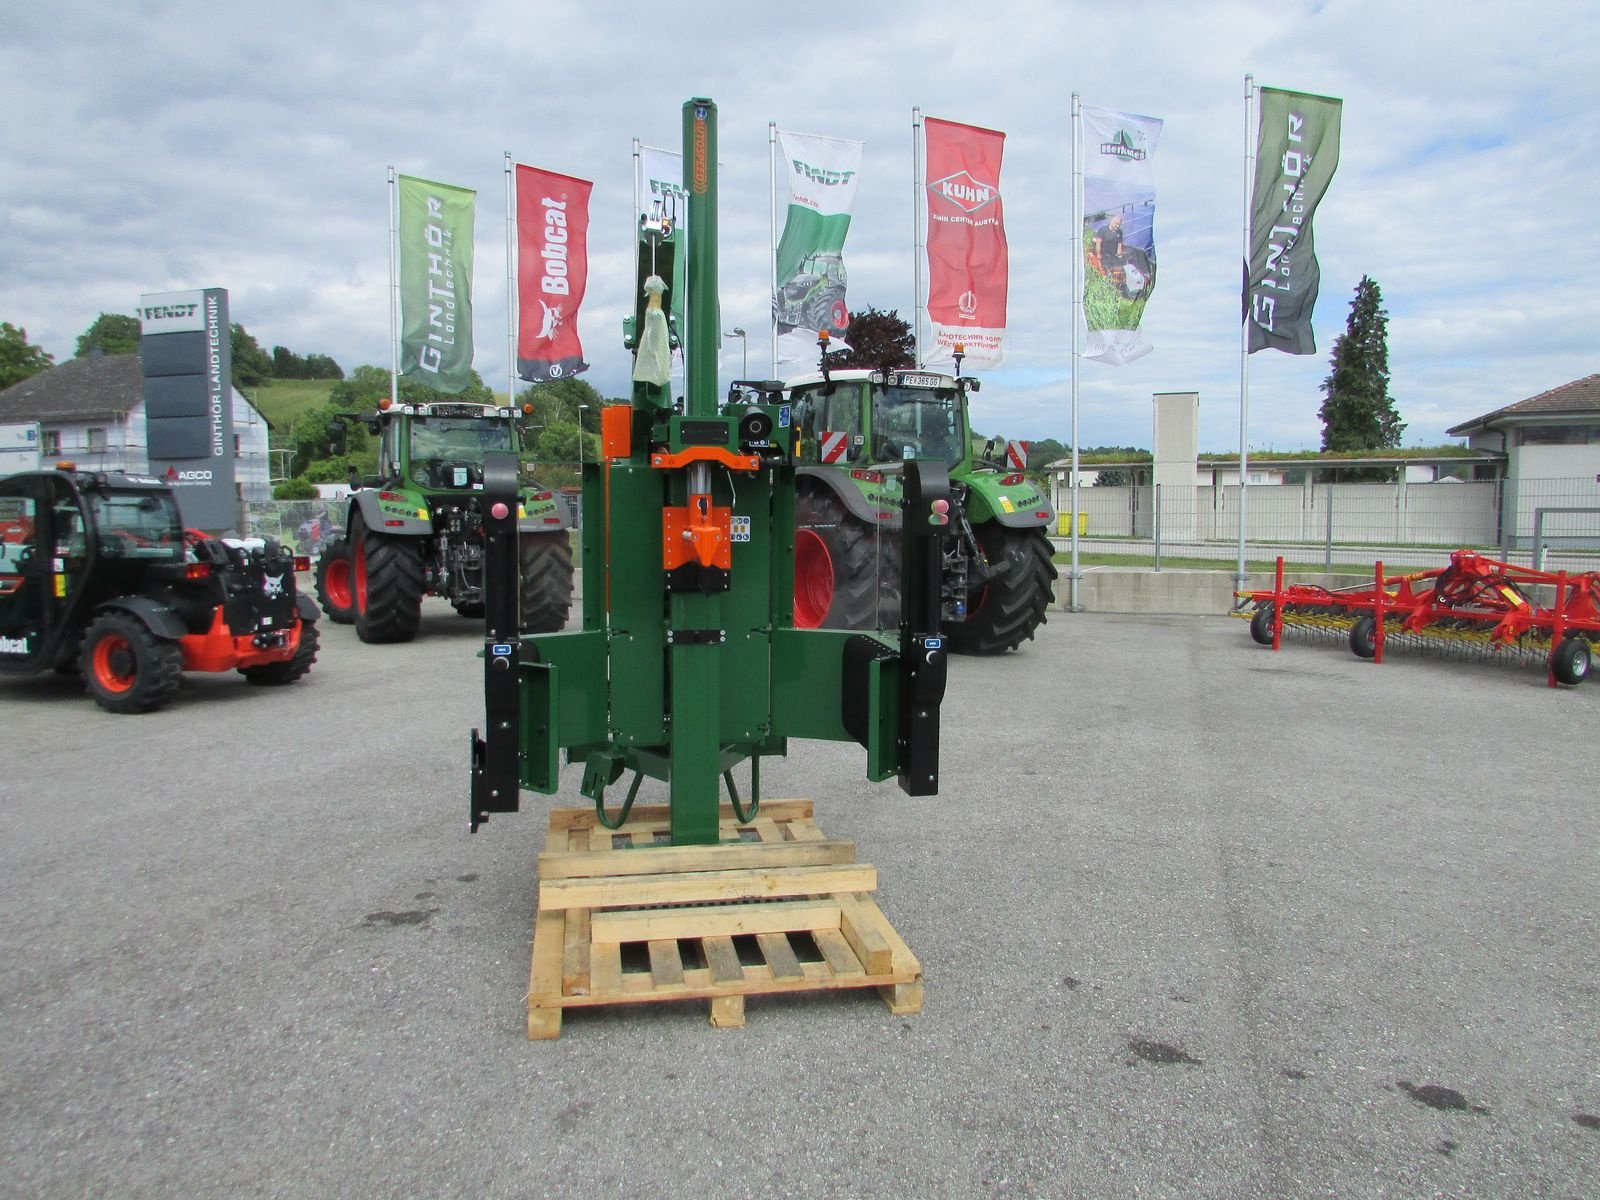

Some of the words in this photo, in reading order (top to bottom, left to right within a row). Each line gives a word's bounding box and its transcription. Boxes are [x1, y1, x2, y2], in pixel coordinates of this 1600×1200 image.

[649, 179, 684, 199] FEN
[942, 181, 990, 203] KUHN
[541, 197, 569, 296] Bobcat
[419, 197, 443, 374] GINTHÖR
[145, 304, 198, 320] FENDT
[207, 296, 221, 391] LANDTECHNIK
[179, 471, 213, 480] AGCO
